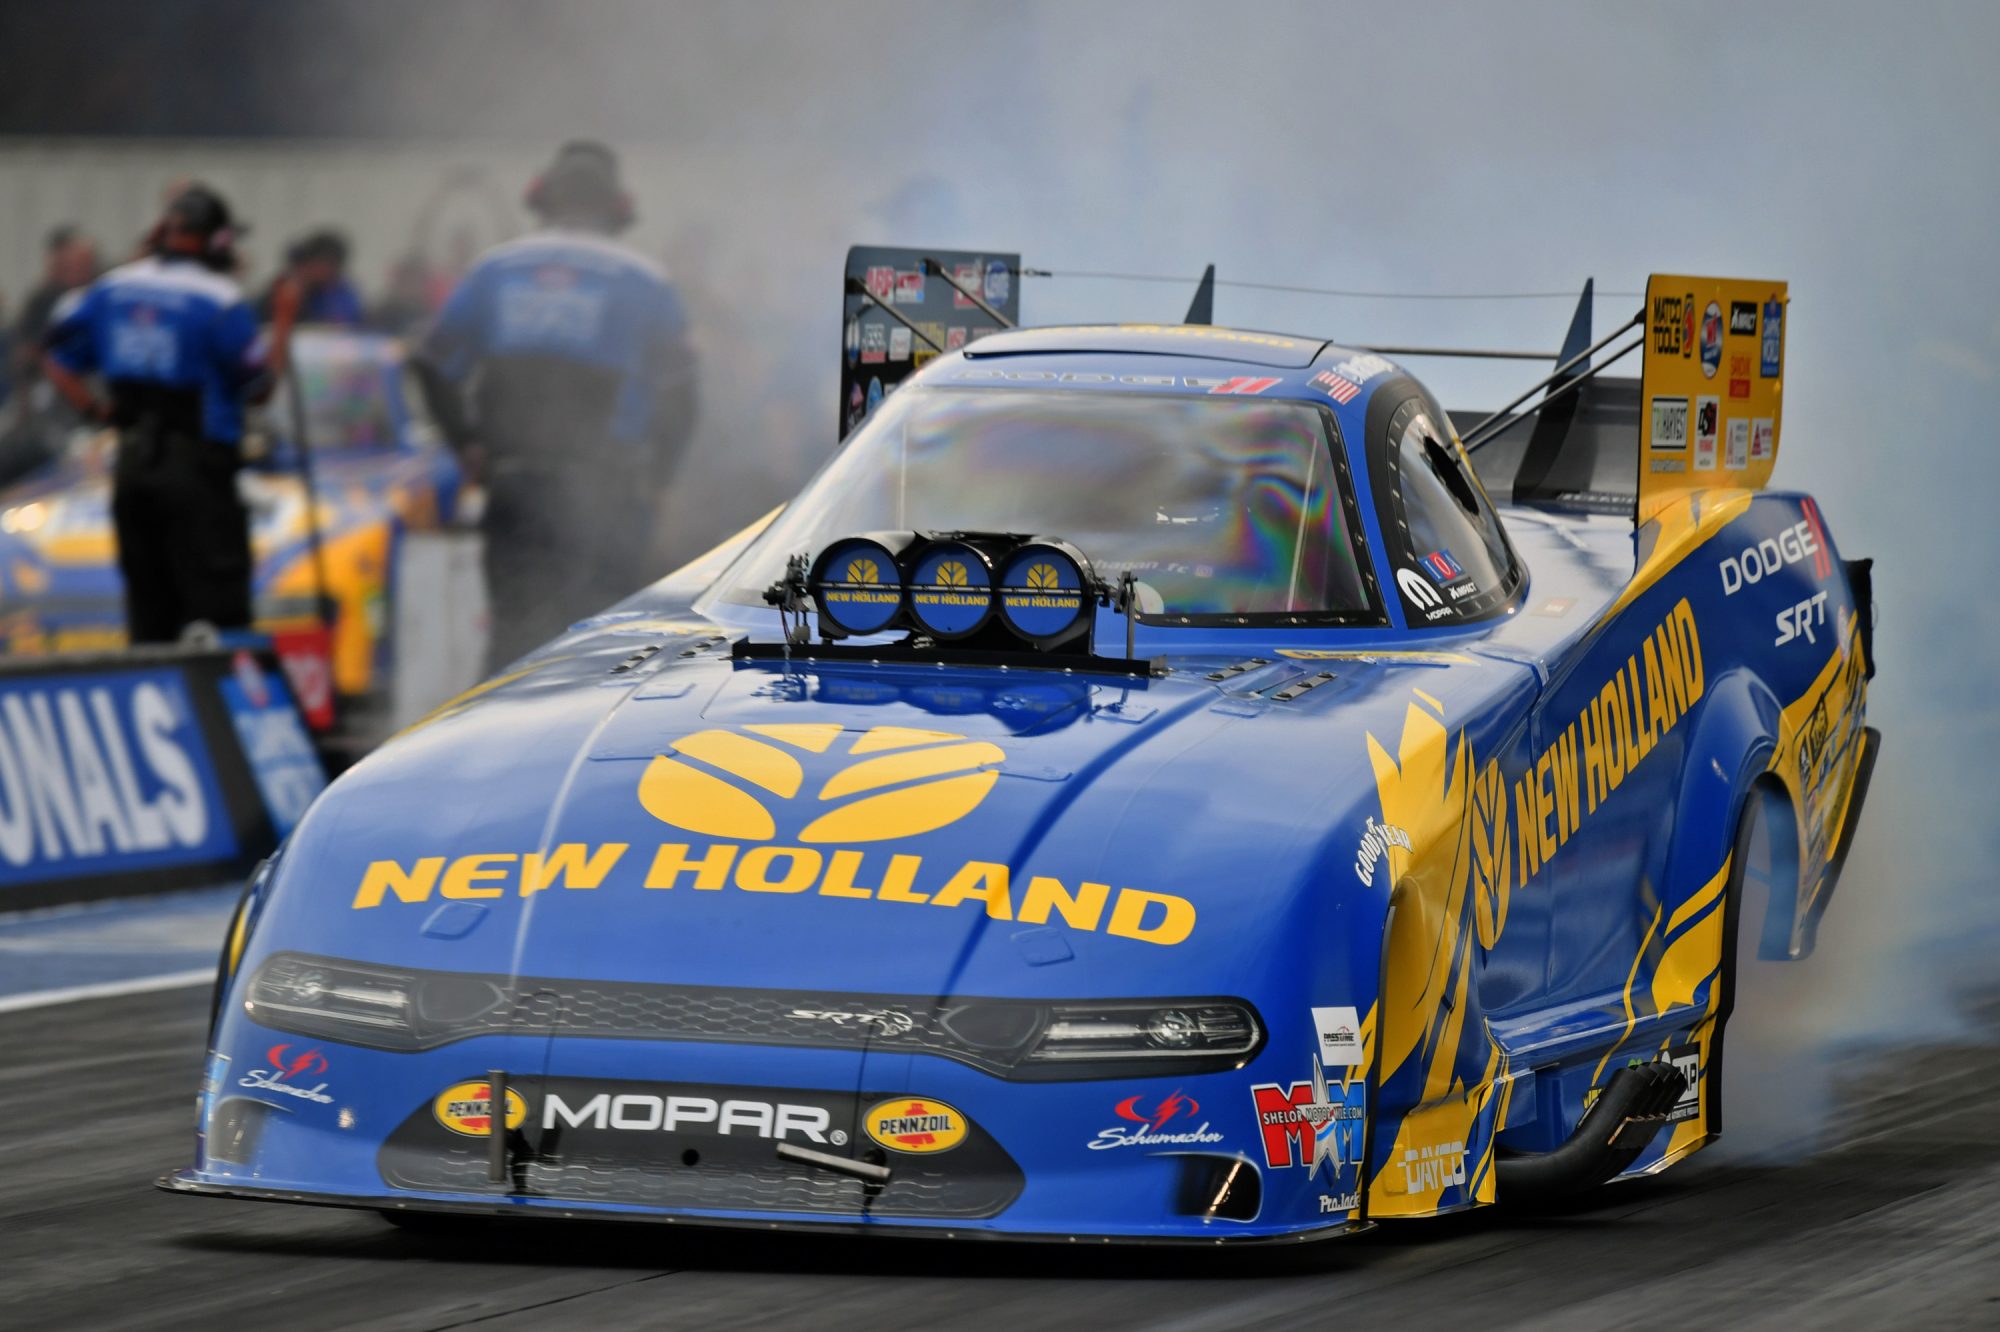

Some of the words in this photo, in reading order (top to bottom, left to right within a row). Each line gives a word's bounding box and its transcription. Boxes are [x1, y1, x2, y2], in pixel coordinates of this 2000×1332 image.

[1654, 297, 1681, 324] MATCO
[1653, 326, 1680, 354] TOOLS
[1719, 520, 1818, 596] DODGE
[826, 591, 850, 603] NEW
[851, 592, 900, 604] HOLLAND
[915, 594, 939, 605] NEW
[941, 594, 989, 606] HOLLAND
[1005, 597, 1030, 607] NEW
[1031, 597, 1080, 608] HOLLAND
[1774, 590, 1828, 648] SRT
[1515, 721, 1580, 889] NEW
[1580, 597, 1704, 816] HOLLAND
[352, 843, 630, 909] NEW
[644, 844, 1196, 946] HOLLAND
[784, 1009, 886, 1025] SRT
[543, 1094, 829, 1144] MOPAR
[879, 1114, 953, 1136] PENNZOIL
[1263, 1109, 1303, 1125] SHELOR
[1087, 1121, 1224, 1150] Schumacher
[1397, 1141, 1470, 1195] DAYCO
